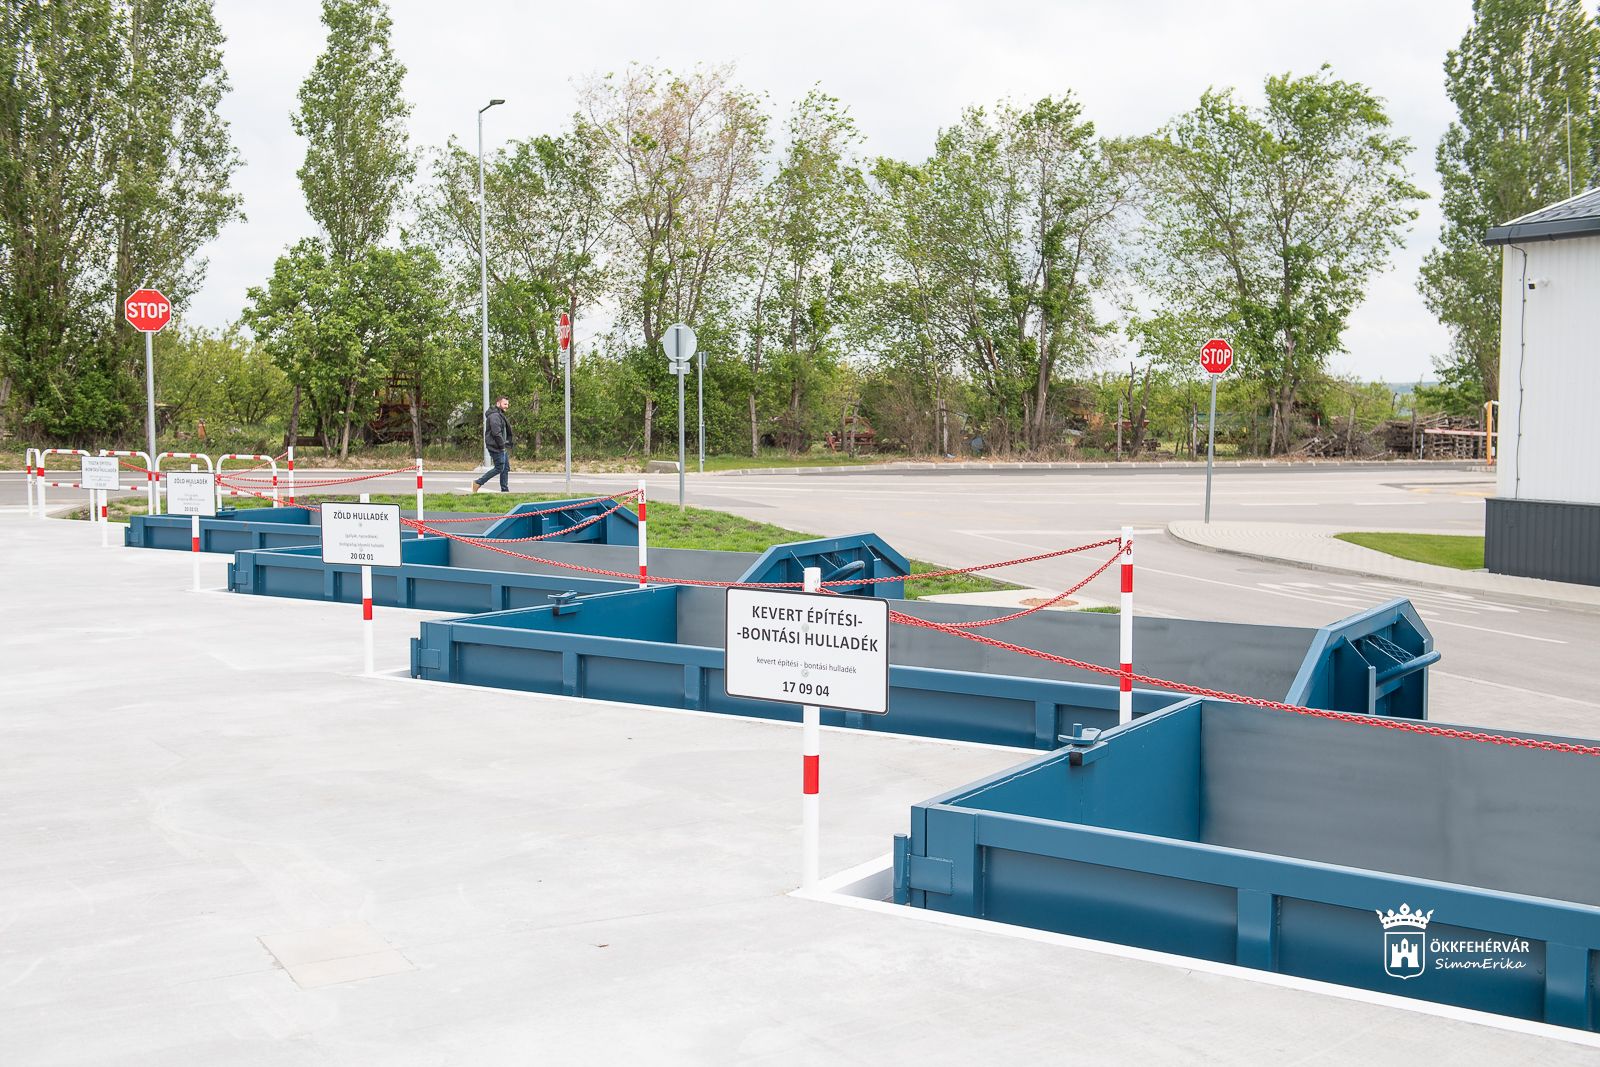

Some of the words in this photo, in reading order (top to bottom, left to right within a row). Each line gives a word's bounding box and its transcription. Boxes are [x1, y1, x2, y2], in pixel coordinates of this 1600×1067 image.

[128, 302, 168, 318] STOP
[1202, 348, 1231, 365] STOP
[333, 510, 352, 520] ZÖLD
[352, 512, 388, 520] HULLADÉK
[752, 606, 803, 622] KEVERT
[807, 607, 862, 627] ÉPÍTÉSI-
[736, 626, 800, 644] -BONTÁSI
[805, 632, 878, 652] HULLADÉK
[756, 656, 776, 665] kevert
[778, 658, 799, 668] építési
[804, 662, 828, 670] bontási
[829, 664, 857, 674] hulladék
[782, 681, 796, 693] 17
[799, 682, 812, 695] 09
[816, 685, 830, 696] 04
